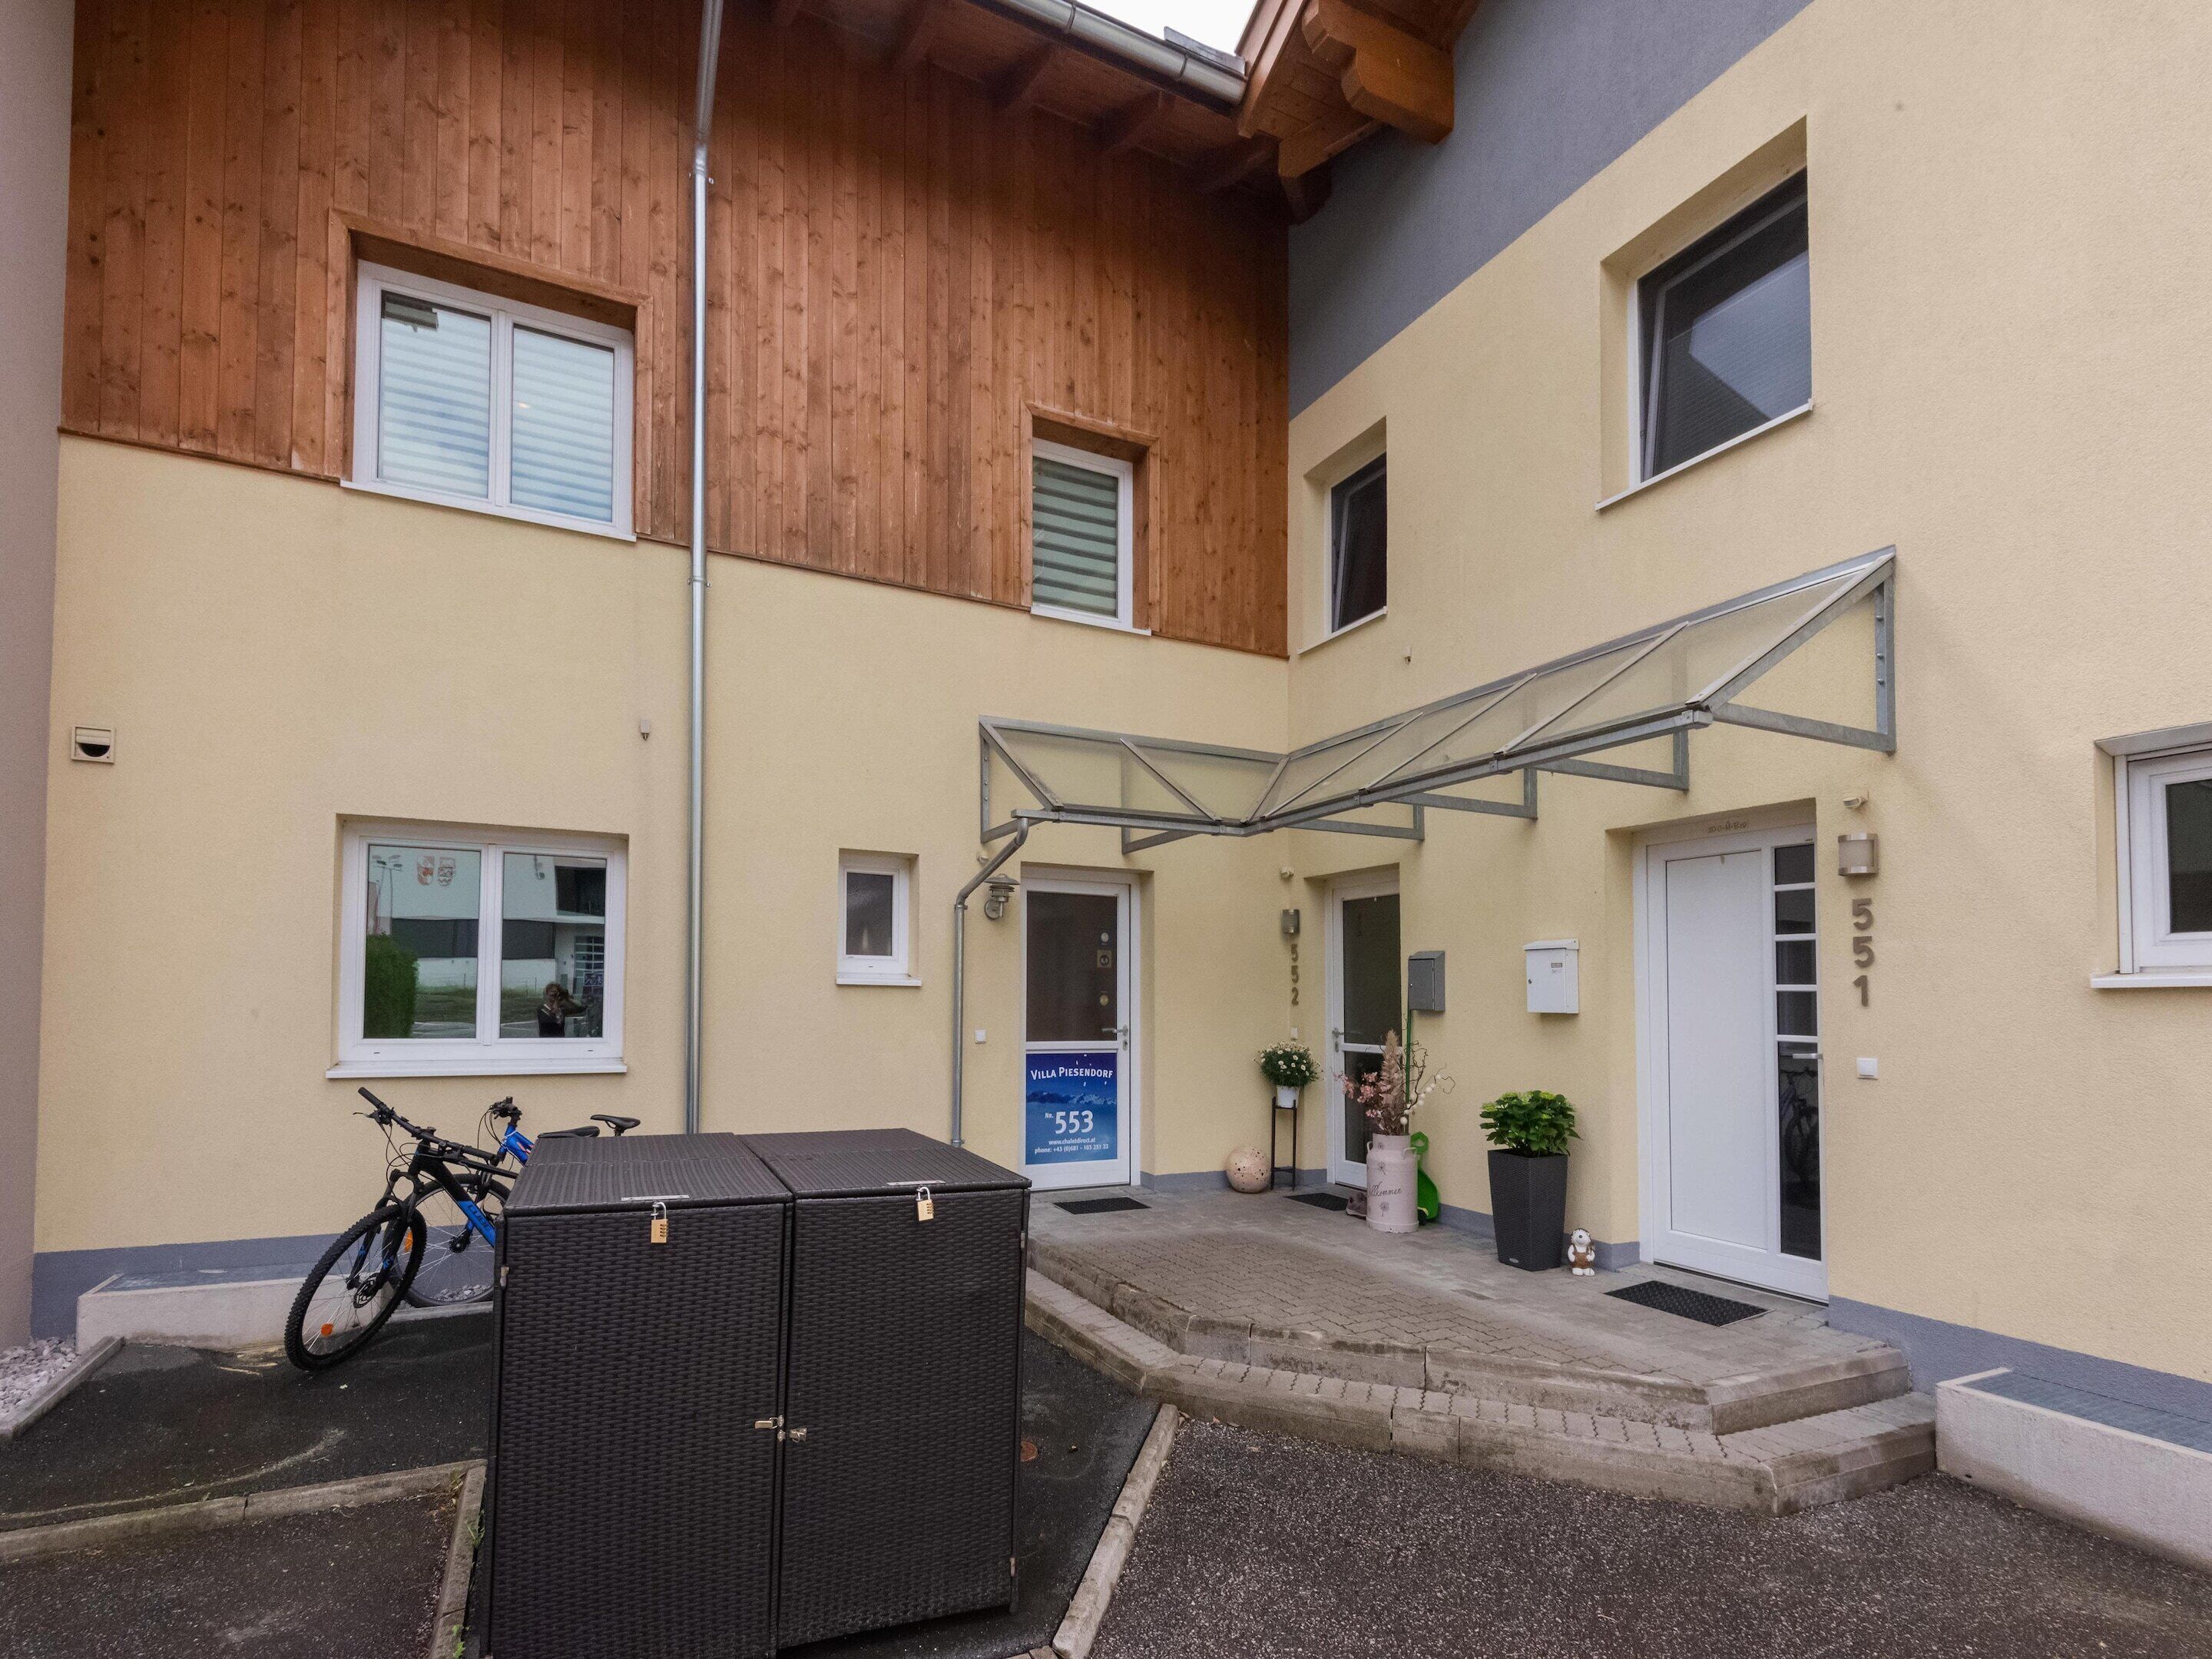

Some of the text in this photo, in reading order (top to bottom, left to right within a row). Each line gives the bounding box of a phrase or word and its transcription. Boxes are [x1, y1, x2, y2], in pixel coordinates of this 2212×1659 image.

[1852, 898, 1875, 1007] 551
[1290, 943, 1300, 1005] 552
[1031, 1067, 1113, 1080] VILLA PIESENDORF
[1055, 1110, 1094, 1134] 553
[1035, 1147, 1052, 1155] phone:
